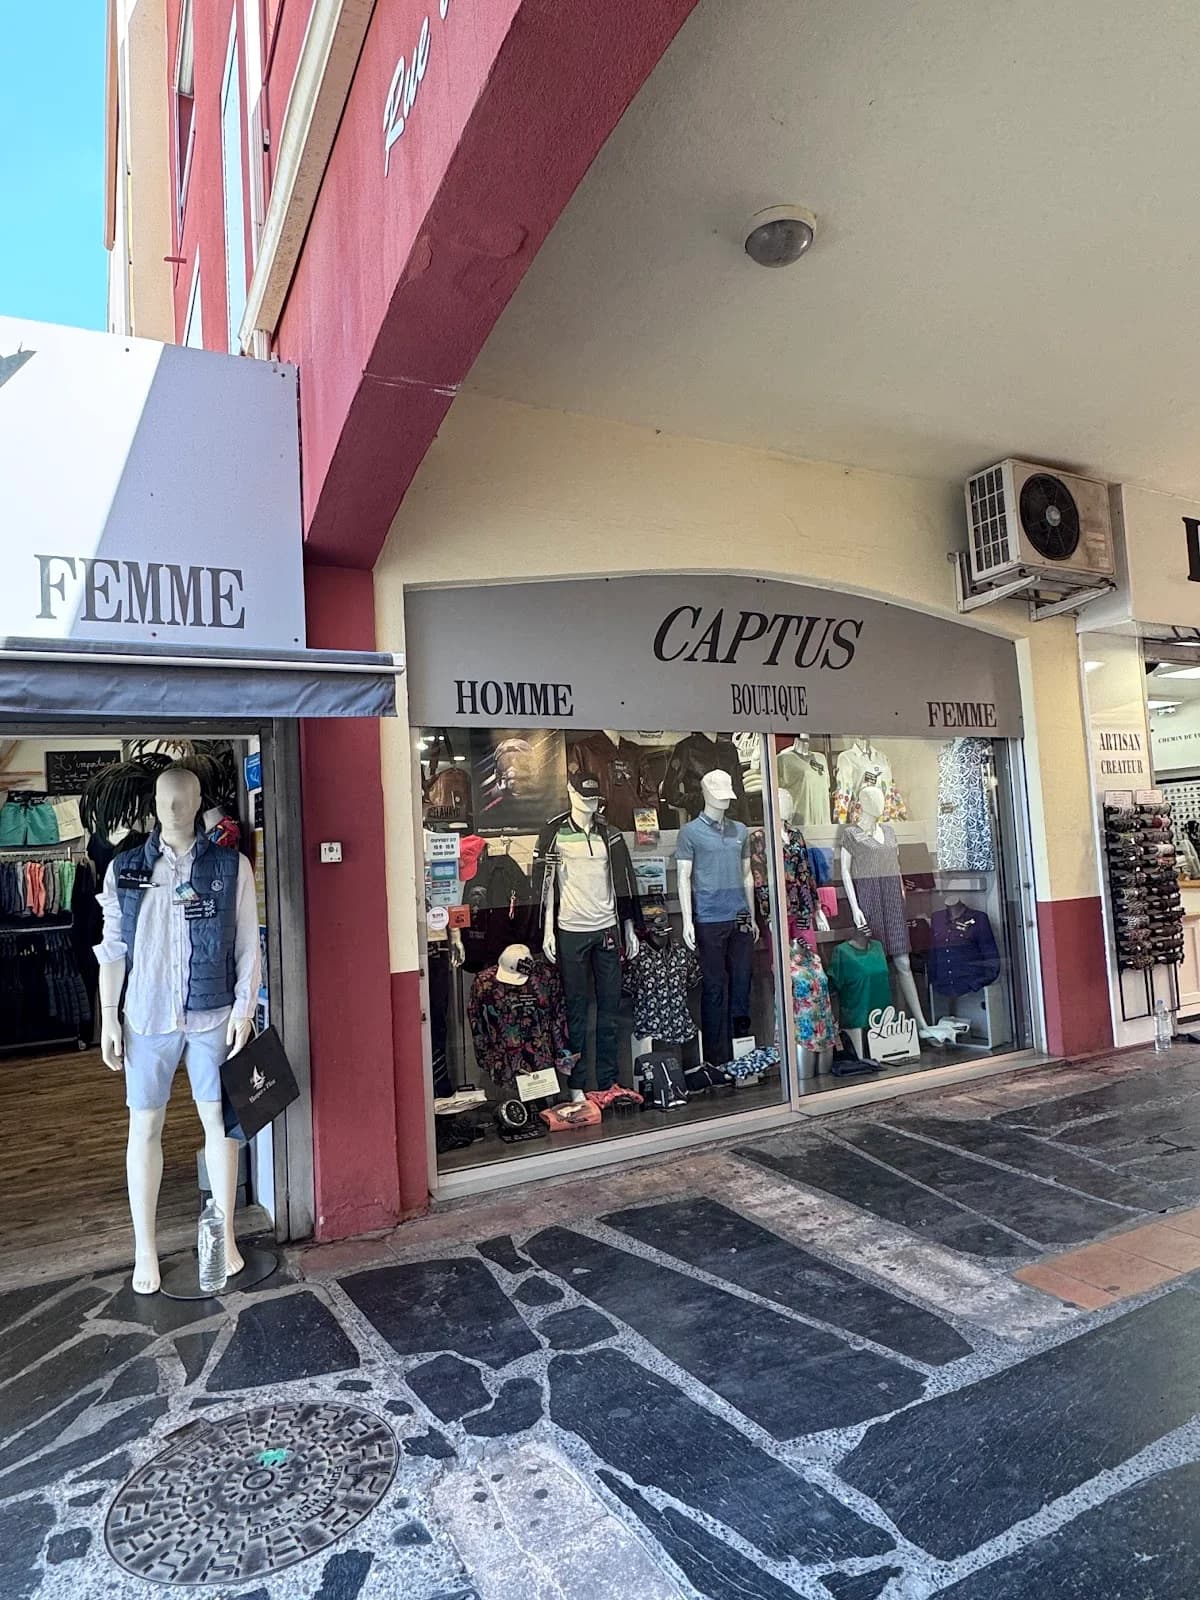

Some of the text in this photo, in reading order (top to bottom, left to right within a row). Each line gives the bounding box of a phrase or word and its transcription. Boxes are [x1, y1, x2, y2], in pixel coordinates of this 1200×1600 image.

[382, 15, 431, 178] Rue
[35, 554, 245, 629] FEMME
[653, 605, 865, 671] CAPTUS
[454, 680, 574, 717] HOMME
[731, 683, 809, 722] BOUTIQUE
[926, 701, 996, 728] FEMME
[1099, 732, 1141, 751] ARTISAN
[1158, 735, 1182, 744] CHEMIN
[1100, 759, 1144, 775] CREATEUR
[870, 1007, 915, 1043] Lady
